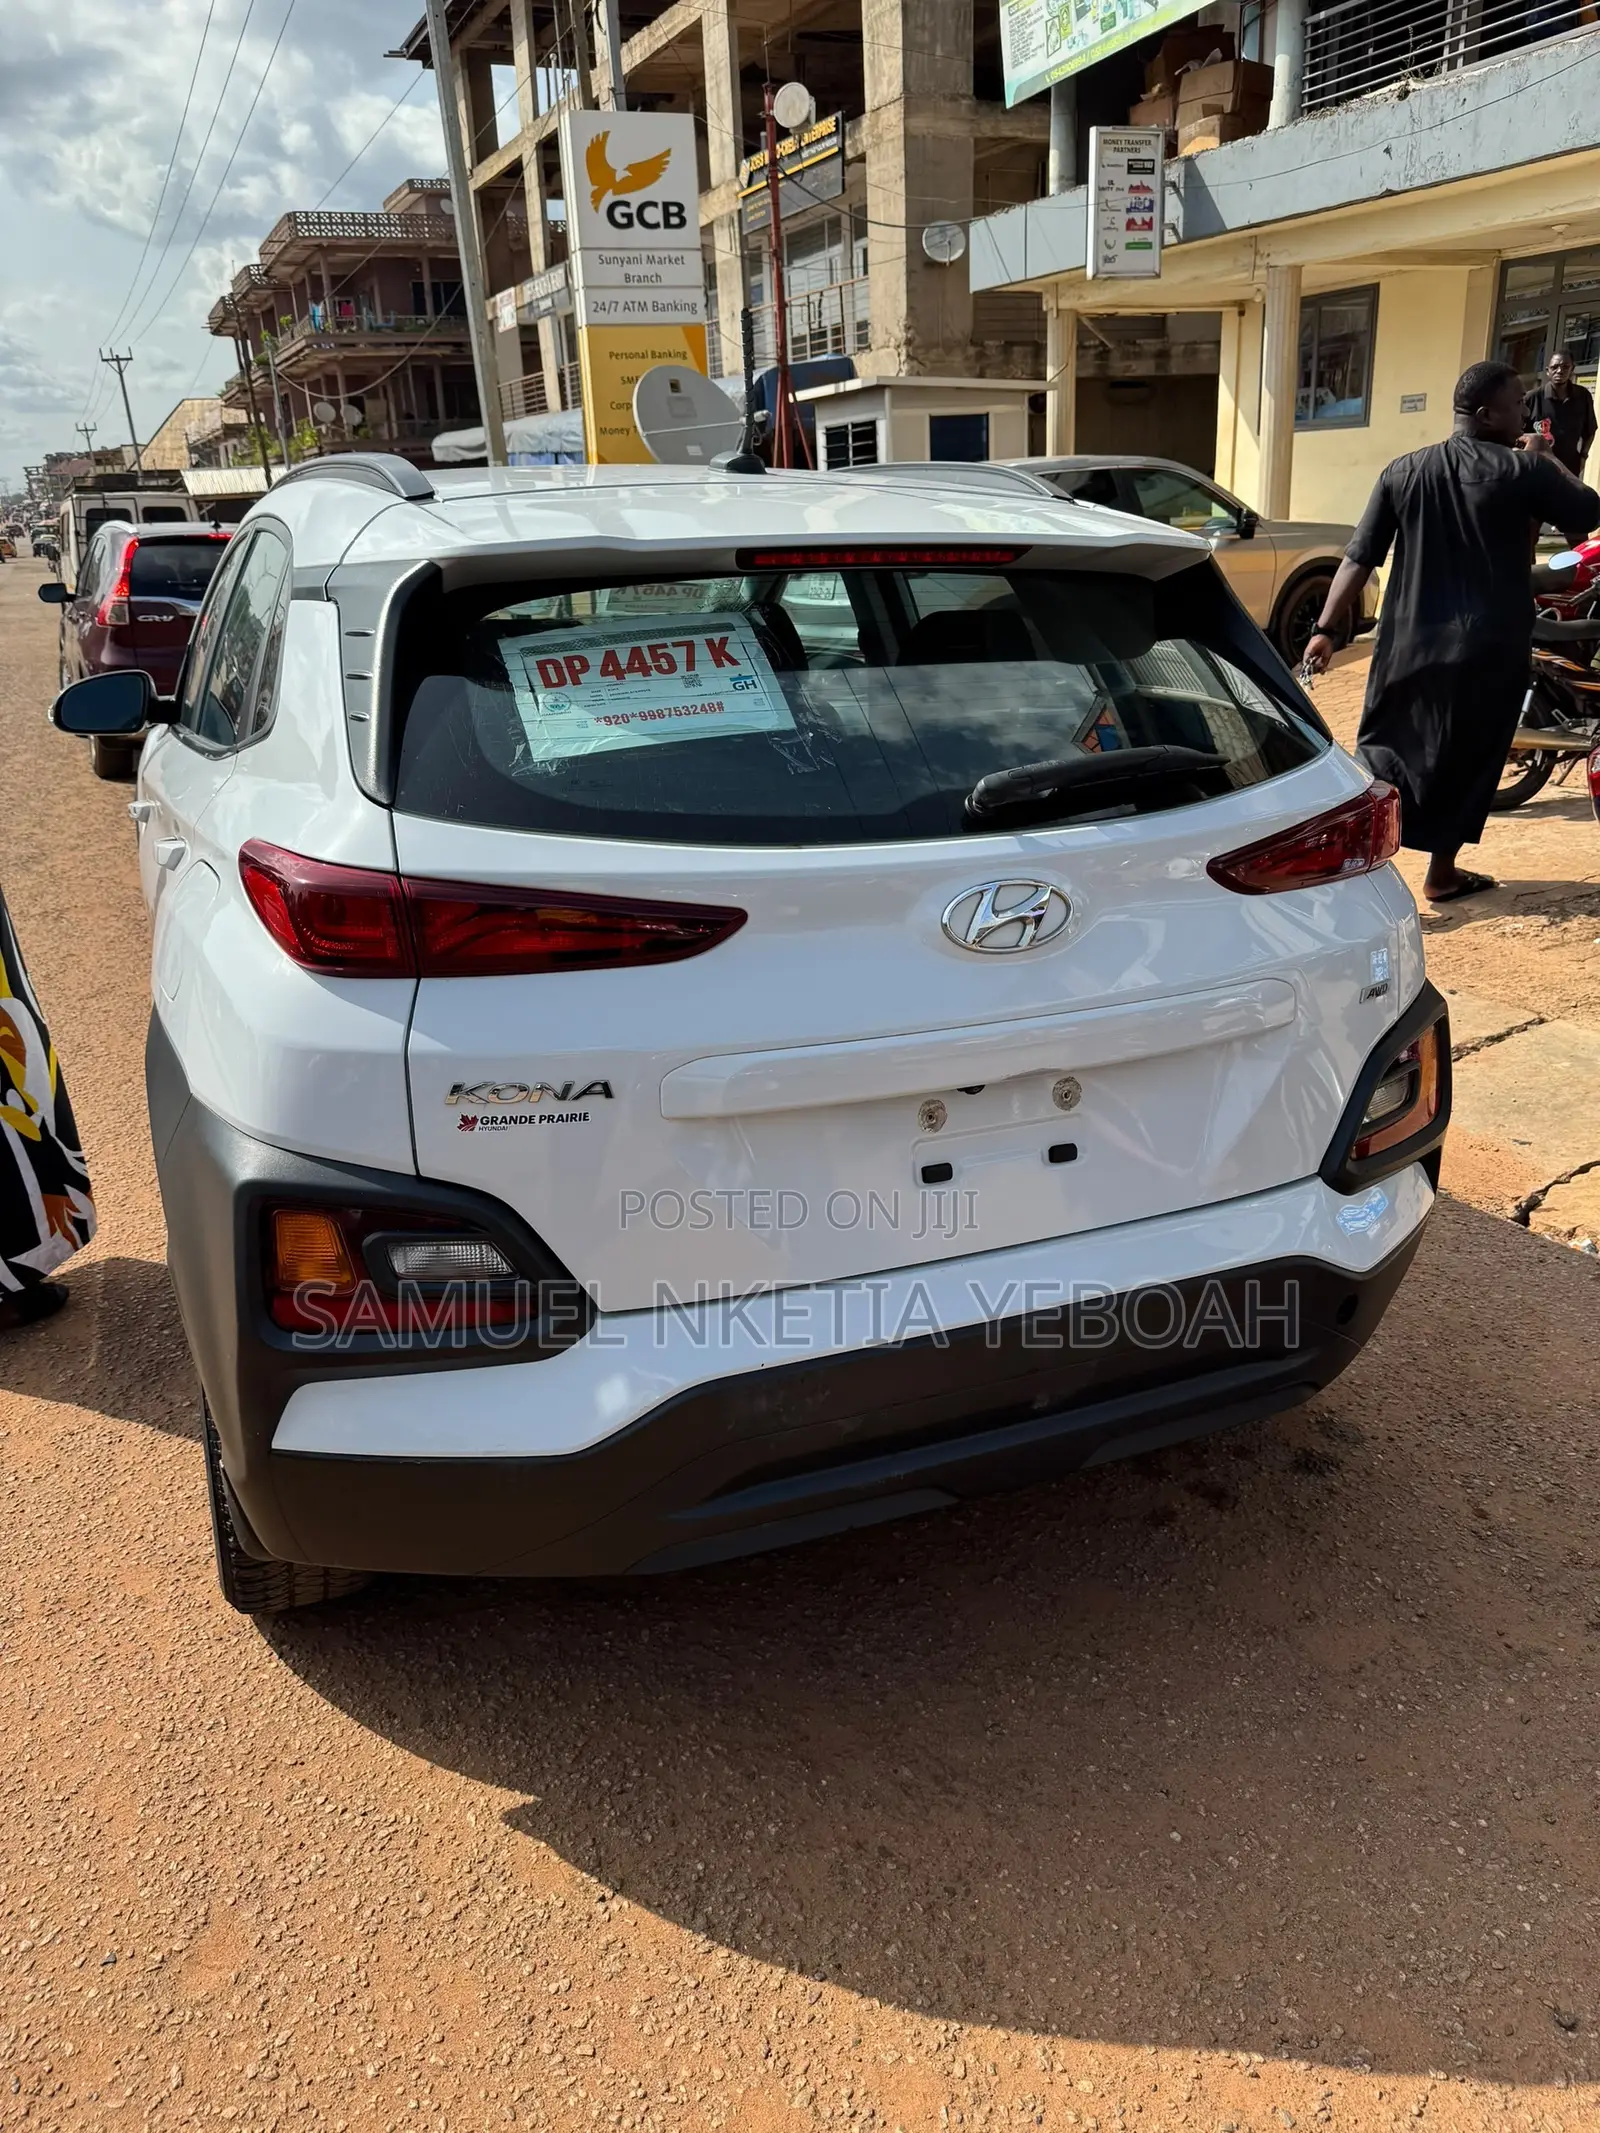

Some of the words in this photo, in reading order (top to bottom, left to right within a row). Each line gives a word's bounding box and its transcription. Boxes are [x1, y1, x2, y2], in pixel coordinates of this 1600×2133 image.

[606, 200, 687, 230] GCB
[598, 254, 643, 267] Sunyani
[646, 254, 686, 265] Market
[624, 273, 662, 283] Branch
[592, 301, 619, 315] 24/7
[623, 301, 648, 312] ATM
[652, 300, 698, 315] Banking
[609, 350, 649, 360] Personal
[651, 350, 688, 360] Banking
[610, 401, 633, 412] Corp
[600, 426, 630, 436] Money
[536, 654, 591, 688] DP
[600, 640, 696, 681] 4457
[704, 636, 741, 668] K
[732, 679, 758, 691] GH
[1366, 983, 1388, 999] AWD
[445, 1079, 615, 1104] KONA
[480, 1114, 536, 1126] GRANDE
[538, 1112, 590, 1124] PRAIRIE
